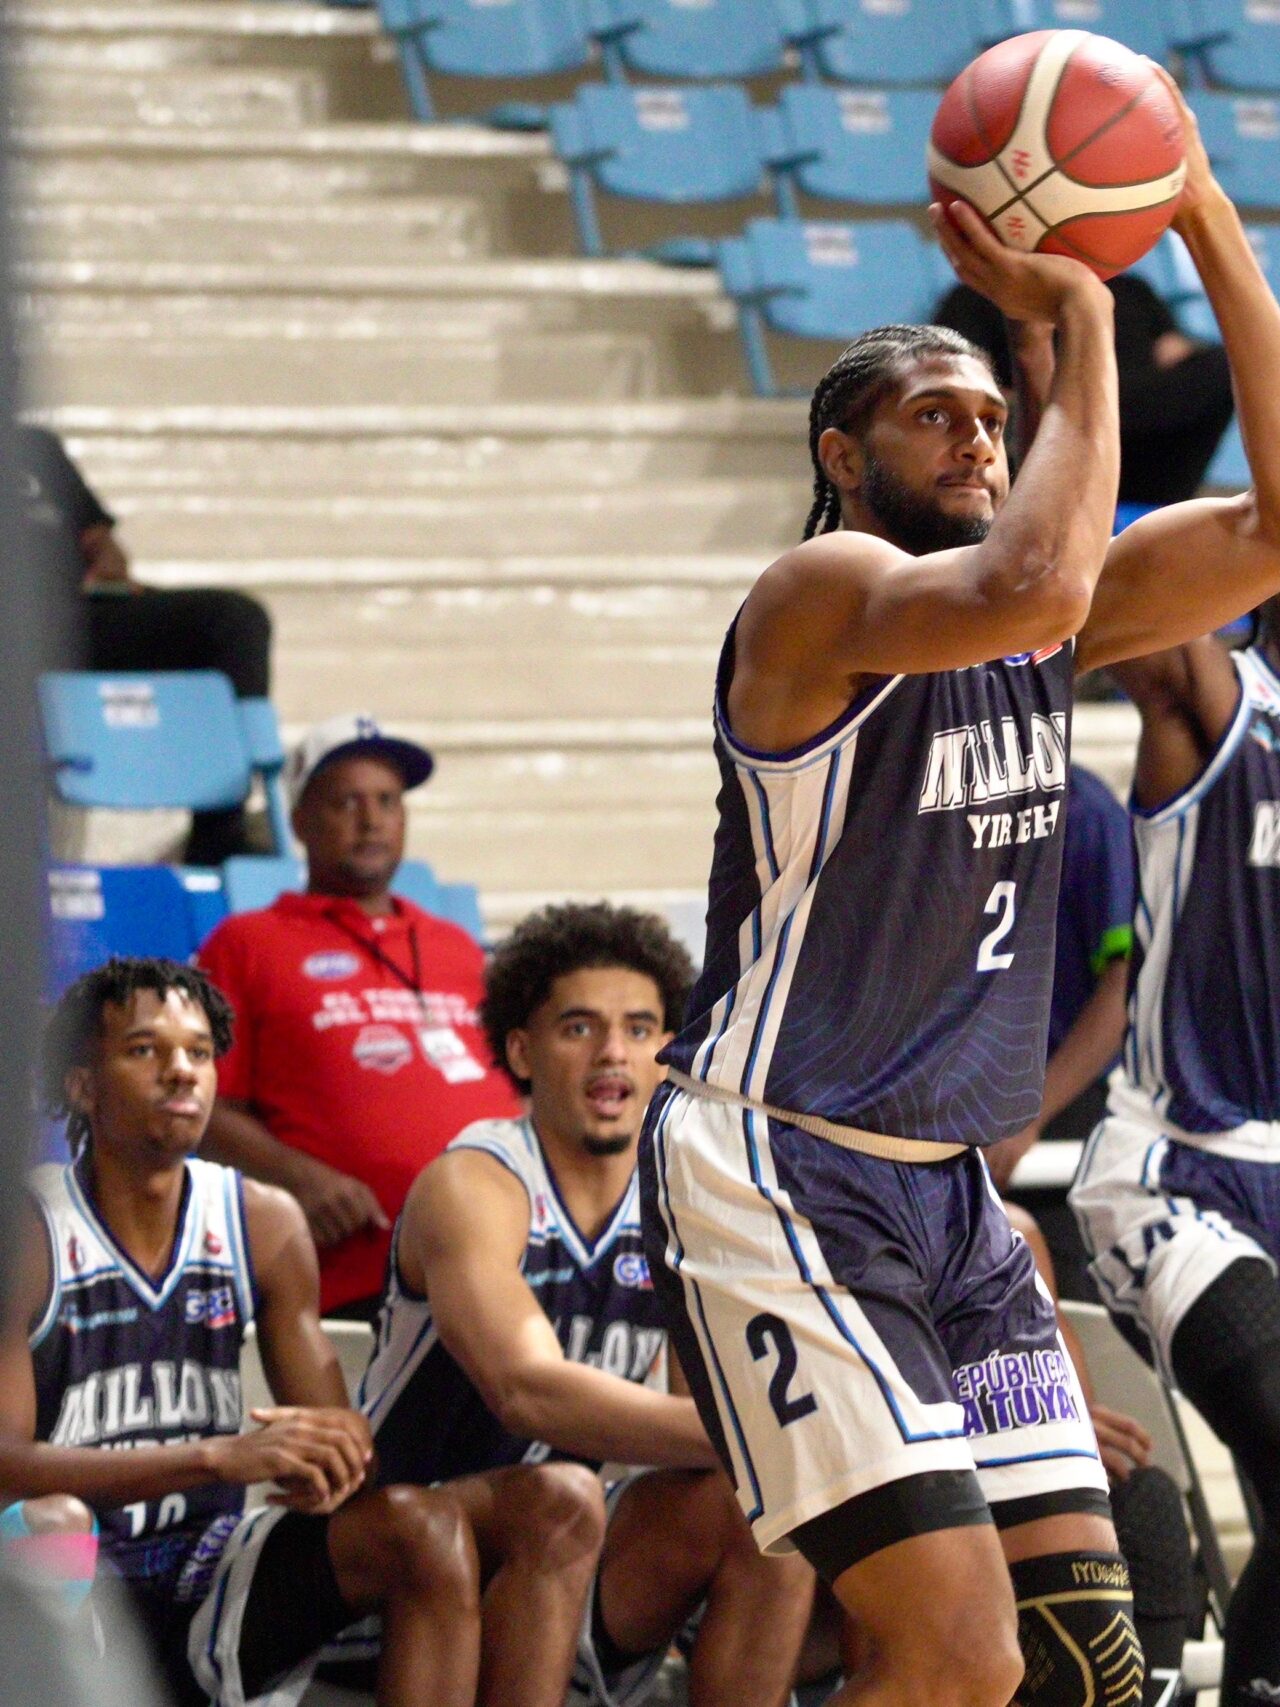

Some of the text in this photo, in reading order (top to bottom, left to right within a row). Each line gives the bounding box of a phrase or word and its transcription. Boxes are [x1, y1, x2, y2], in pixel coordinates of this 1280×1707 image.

[975, 880, 1016, 973] 2
[745, 1312, 819, 1429] 2
[986, 1384, 1078, 1431] TUYA
